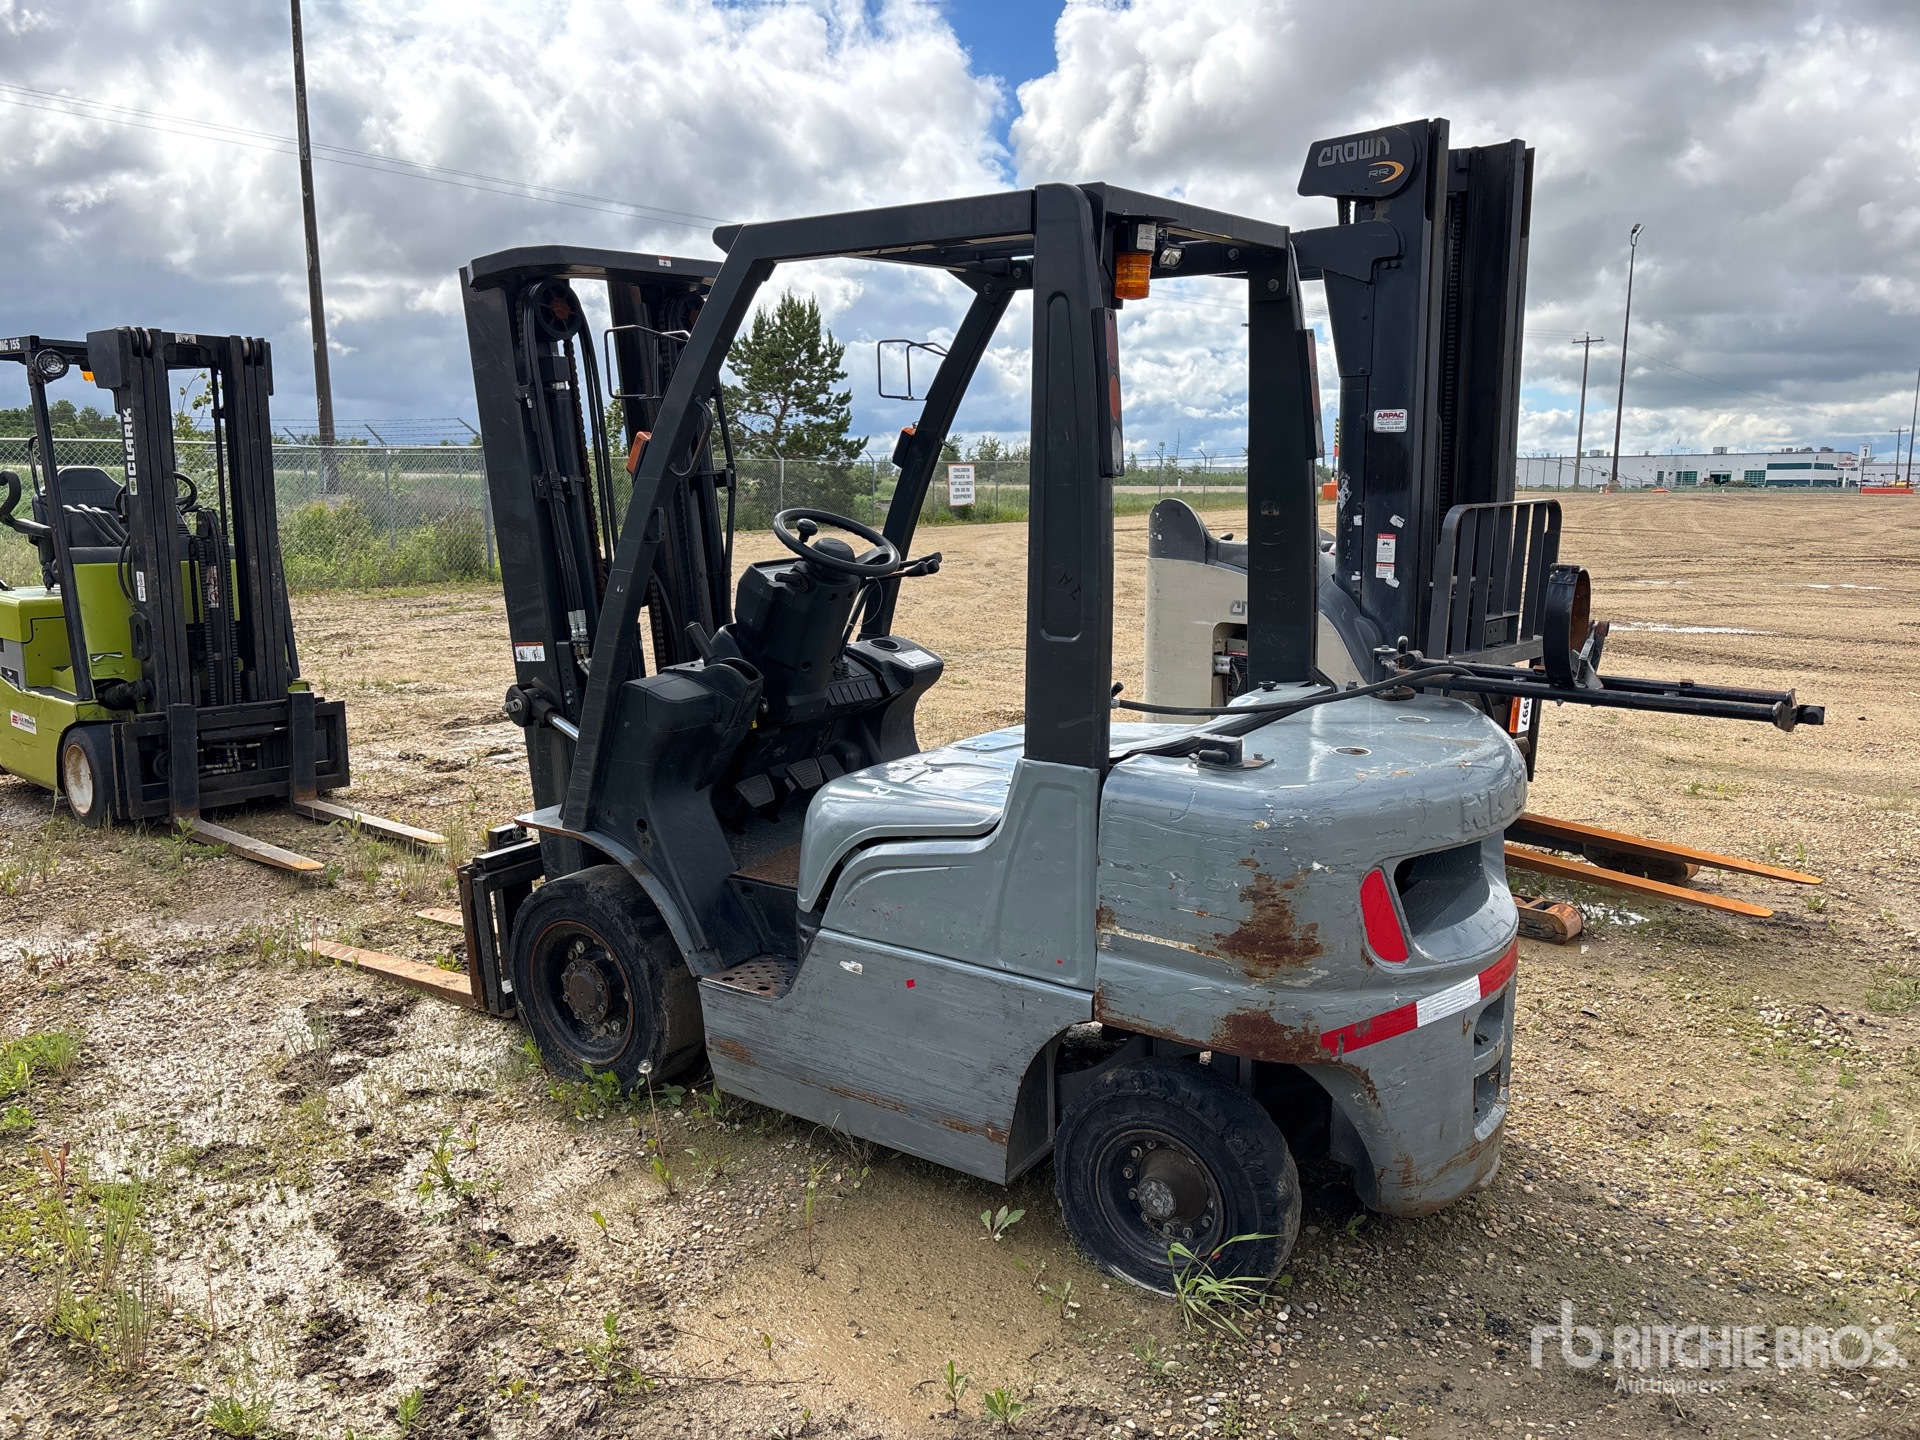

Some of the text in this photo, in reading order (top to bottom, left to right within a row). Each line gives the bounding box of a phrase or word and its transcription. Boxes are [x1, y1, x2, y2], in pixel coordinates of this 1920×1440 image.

[1317, 136, 1390, 167] CROWN
[1368, 168, 1389, 178] RR
[122, 407, 137, 476] CLARK
